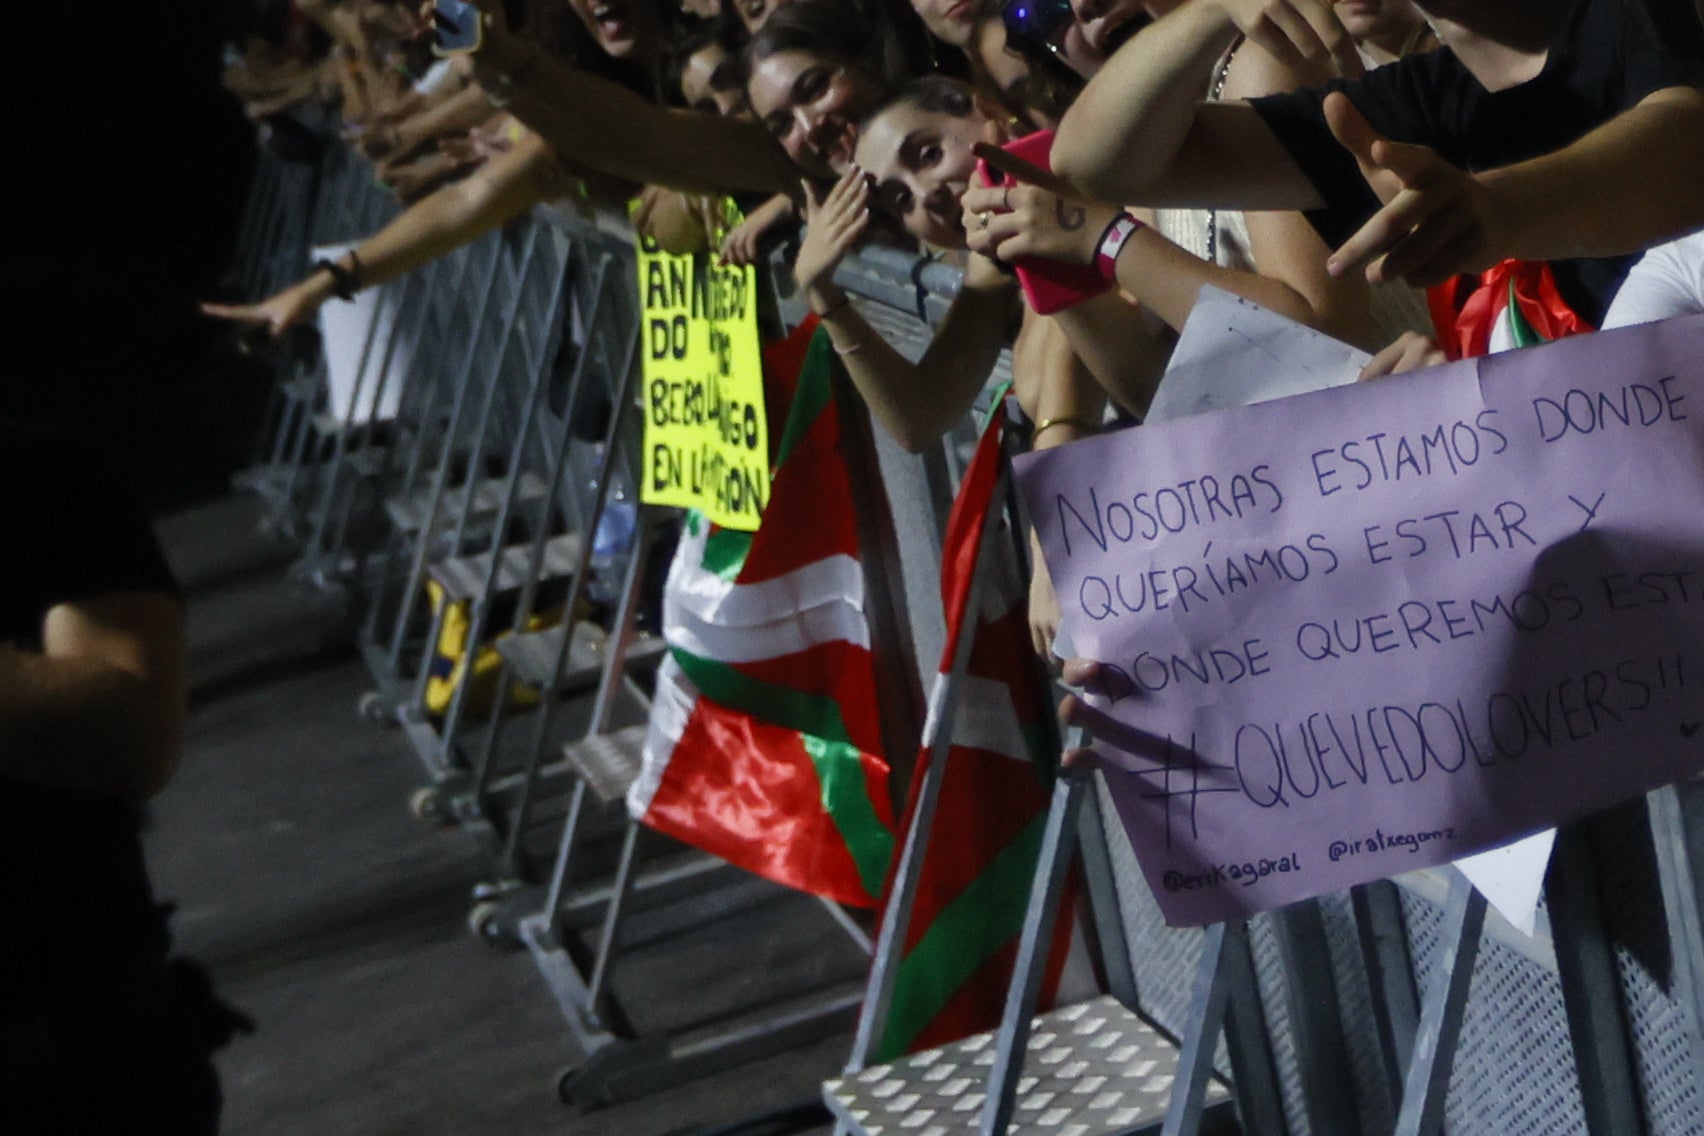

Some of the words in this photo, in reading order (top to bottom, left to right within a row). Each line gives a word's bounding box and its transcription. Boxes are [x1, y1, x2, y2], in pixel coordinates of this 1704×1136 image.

[1055, 465, 1285, 557] NOSOTRAS
[1311, 408, 1510, 498] ESTAMOS
[1533, 375, 1689, 444] DONDE
[1079, 533, 1341, 623] QUERÍAMOS
[1368, 502, 1538, 566] ESTAR
[1567, 491, 1606, 534] Y
[1098, 638, 1272, 705] DONDE
[1296, 580, 1591, 661] QUEREMOS
